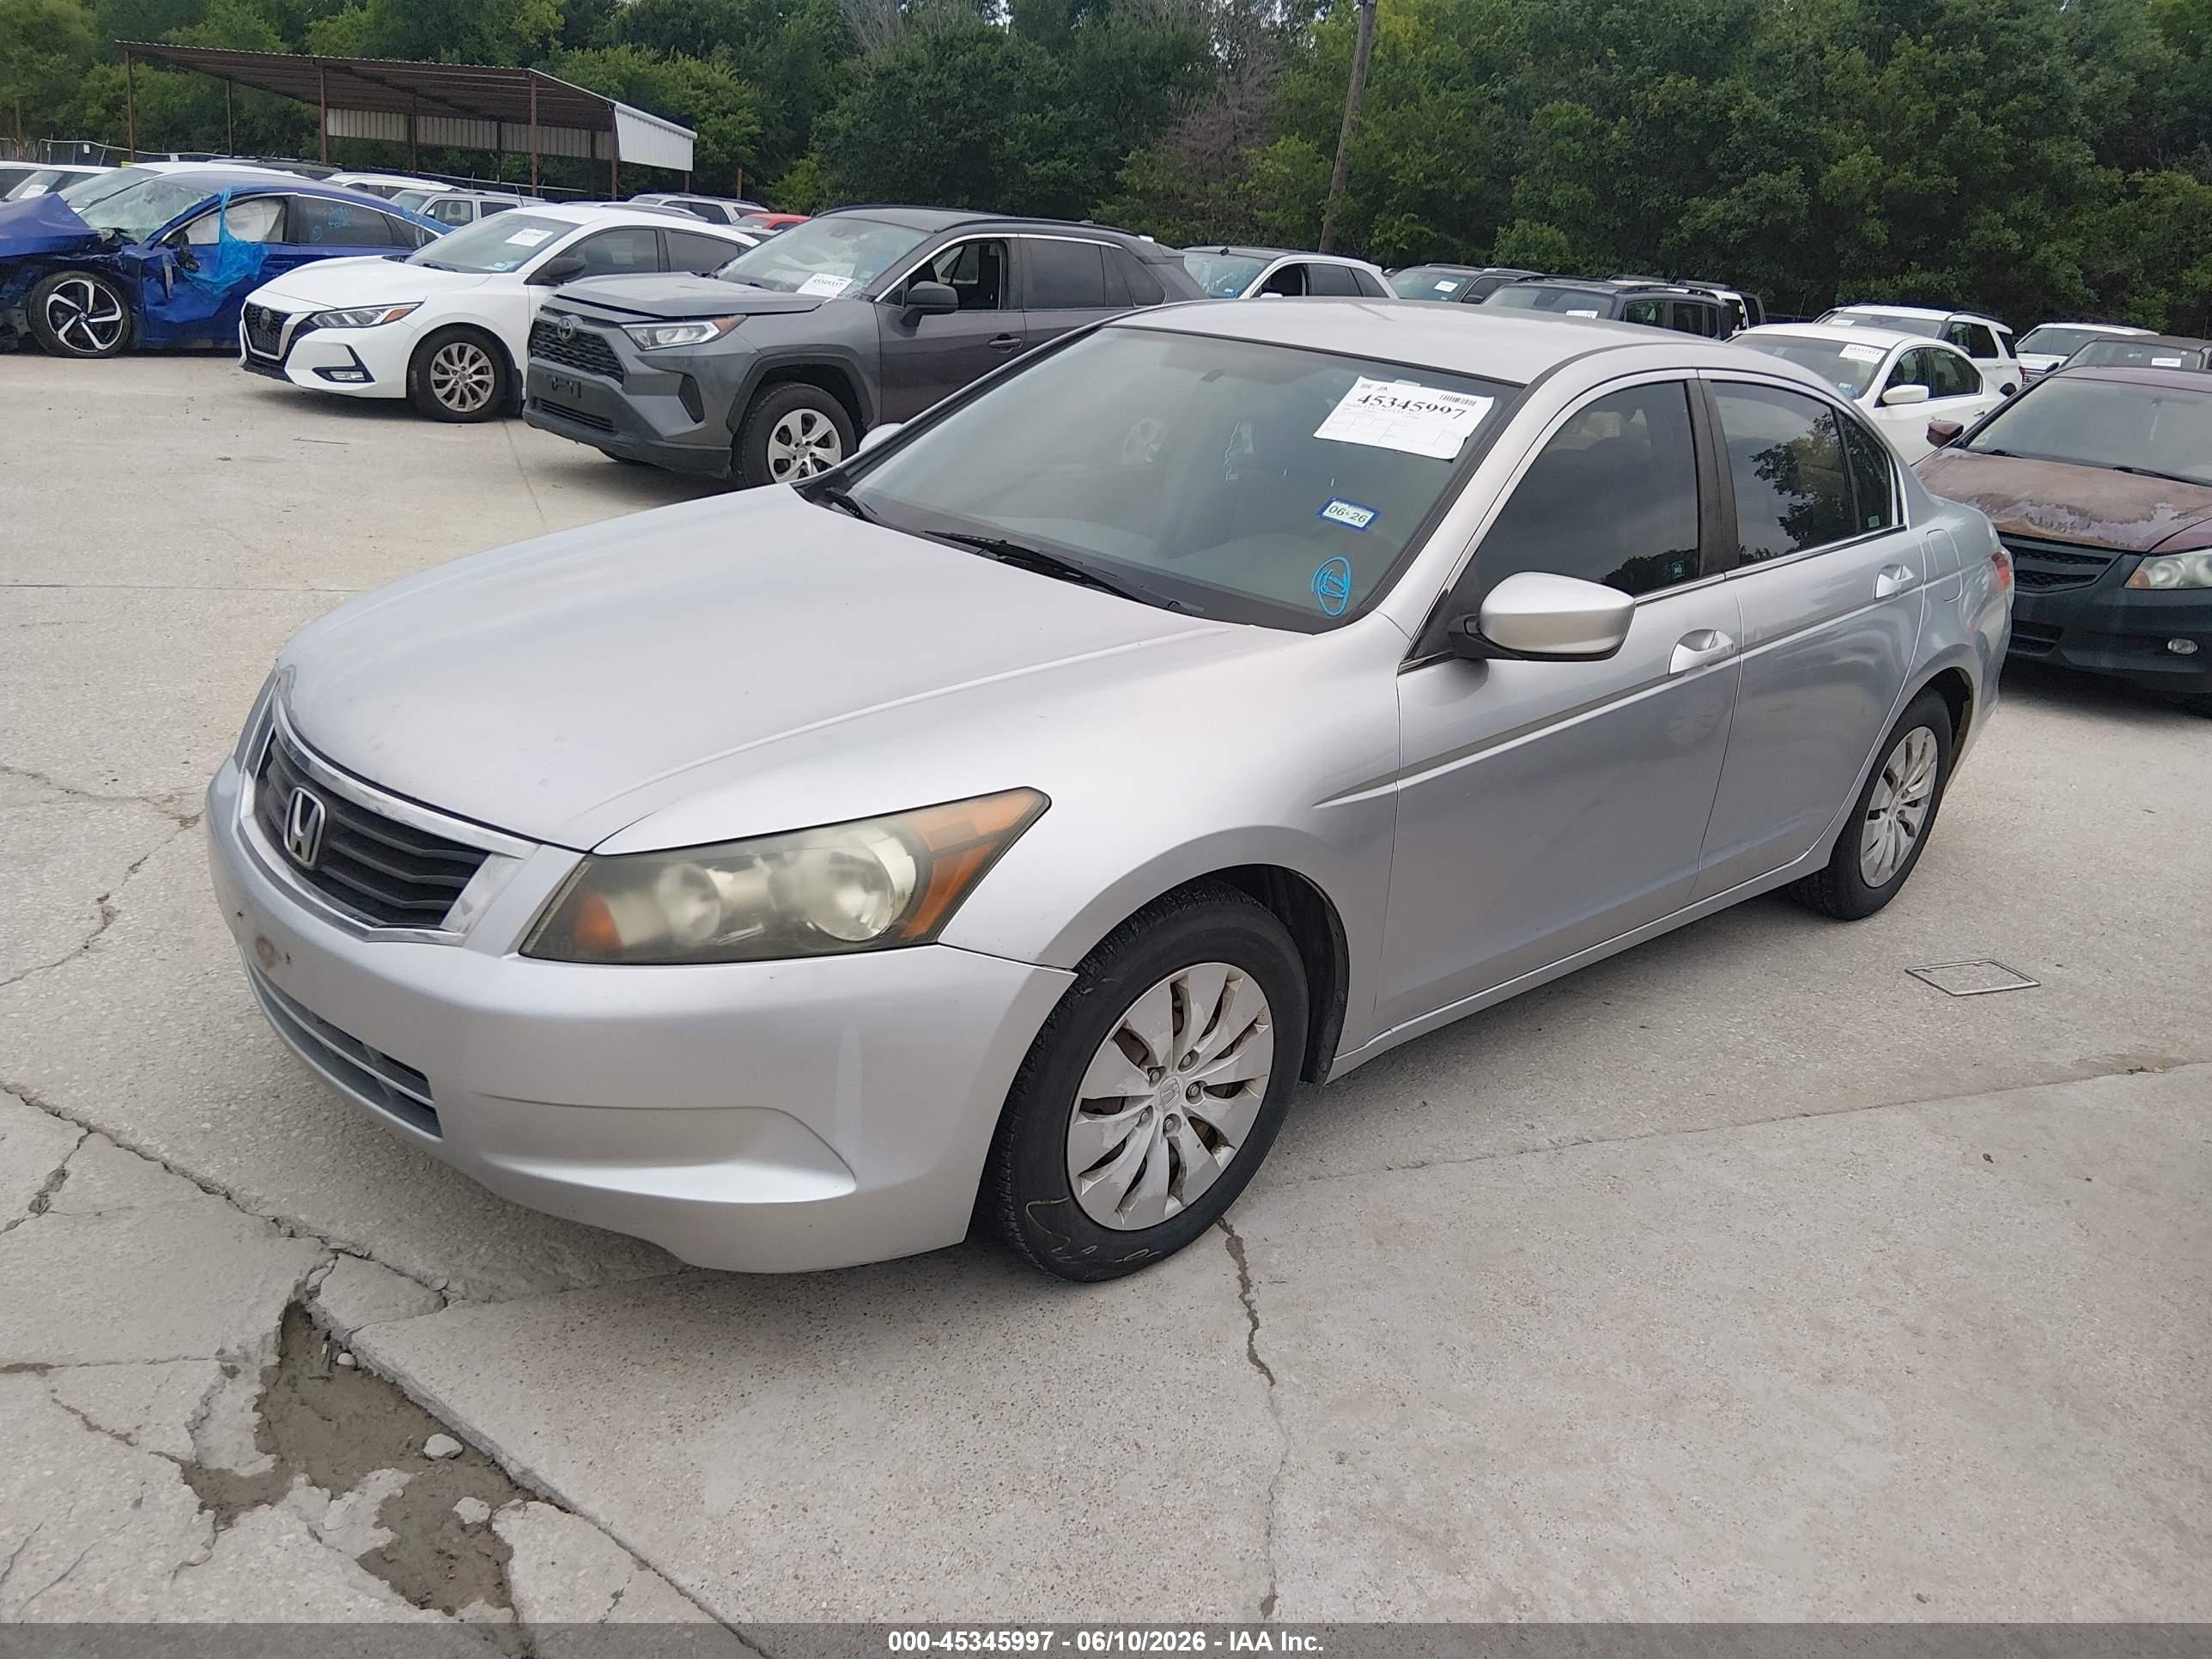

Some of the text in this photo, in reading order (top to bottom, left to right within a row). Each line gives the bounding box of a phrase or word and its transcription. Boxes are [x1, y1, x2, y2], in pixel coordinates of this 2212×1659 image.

[1358, 393, 1467, 419] 45345997
[1328, 506, 1368, 523] 06 26
